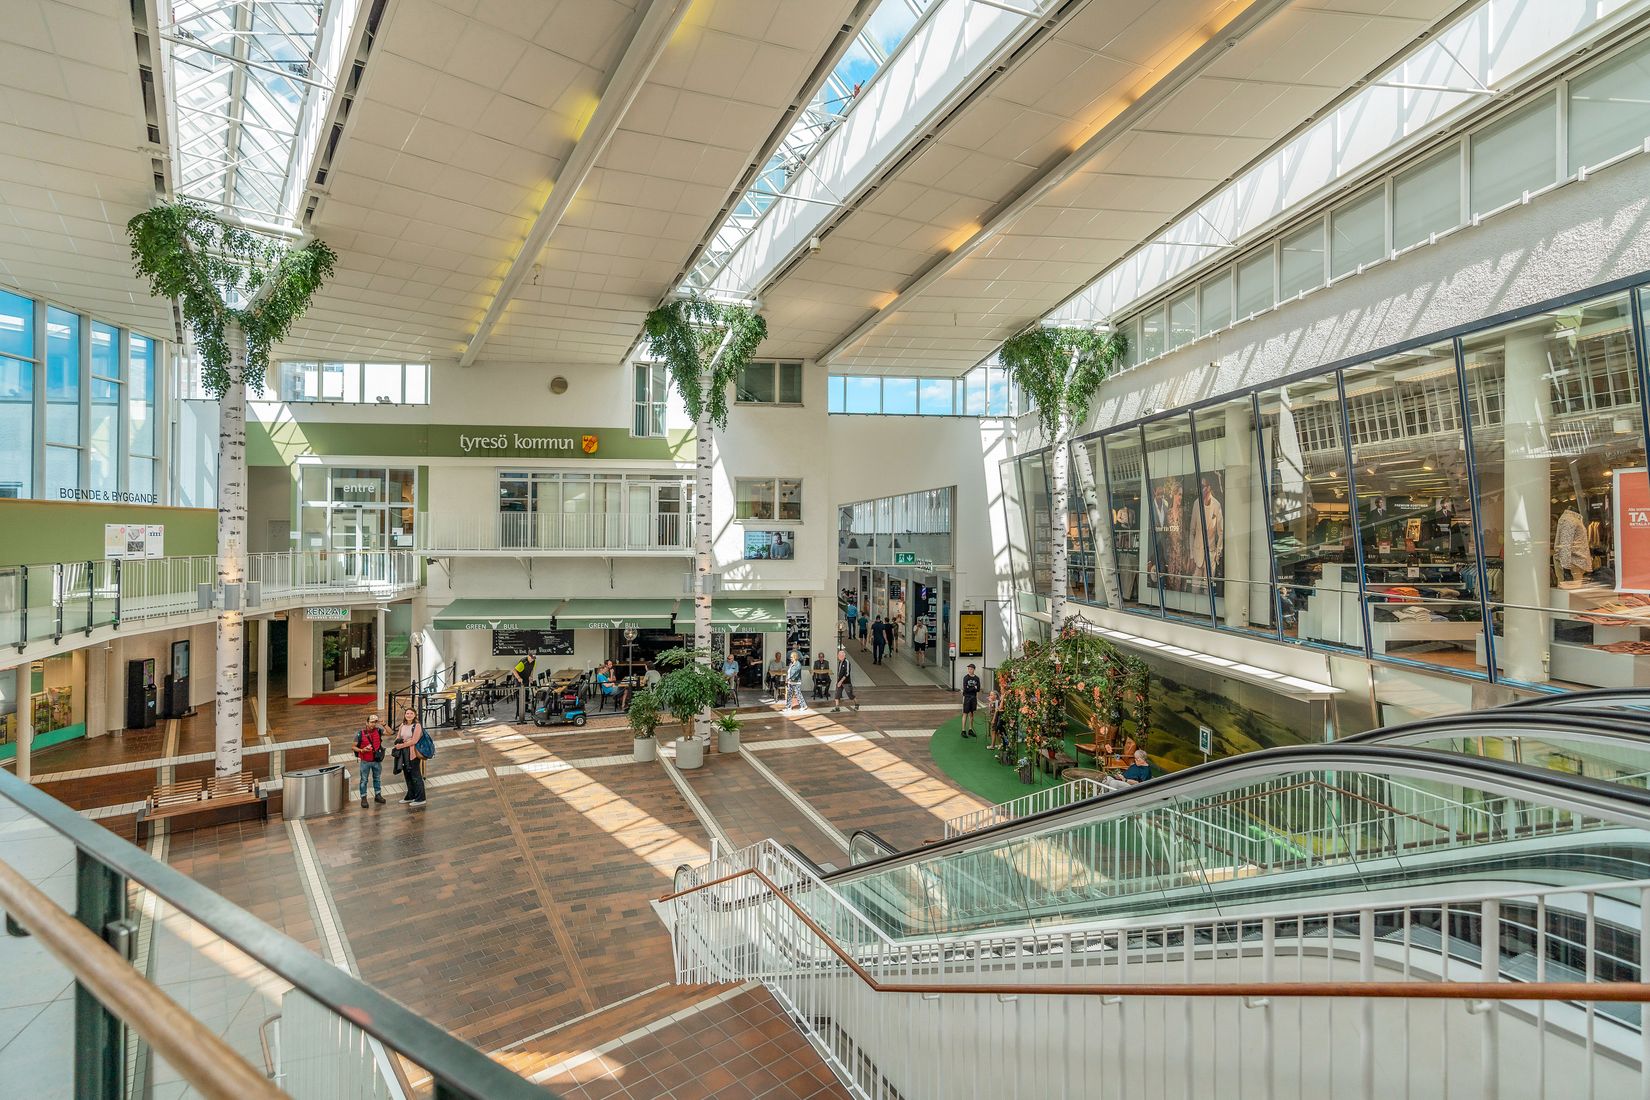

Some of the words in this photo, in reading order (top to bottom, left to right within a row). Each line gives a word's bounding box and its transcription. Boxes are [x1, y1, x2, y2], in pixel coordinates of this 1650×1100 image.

[460, 434, 508, 452] tyresö
[513, 433, 574, 450] kommun
[343, 482, 375, 493] entré
[60, 487, 101, 500] BOENDE
[103, 490, 110, 501] &
[111, 491, 158, 504] BYGGANDE
[1628, 511, 1648, 523] TA
